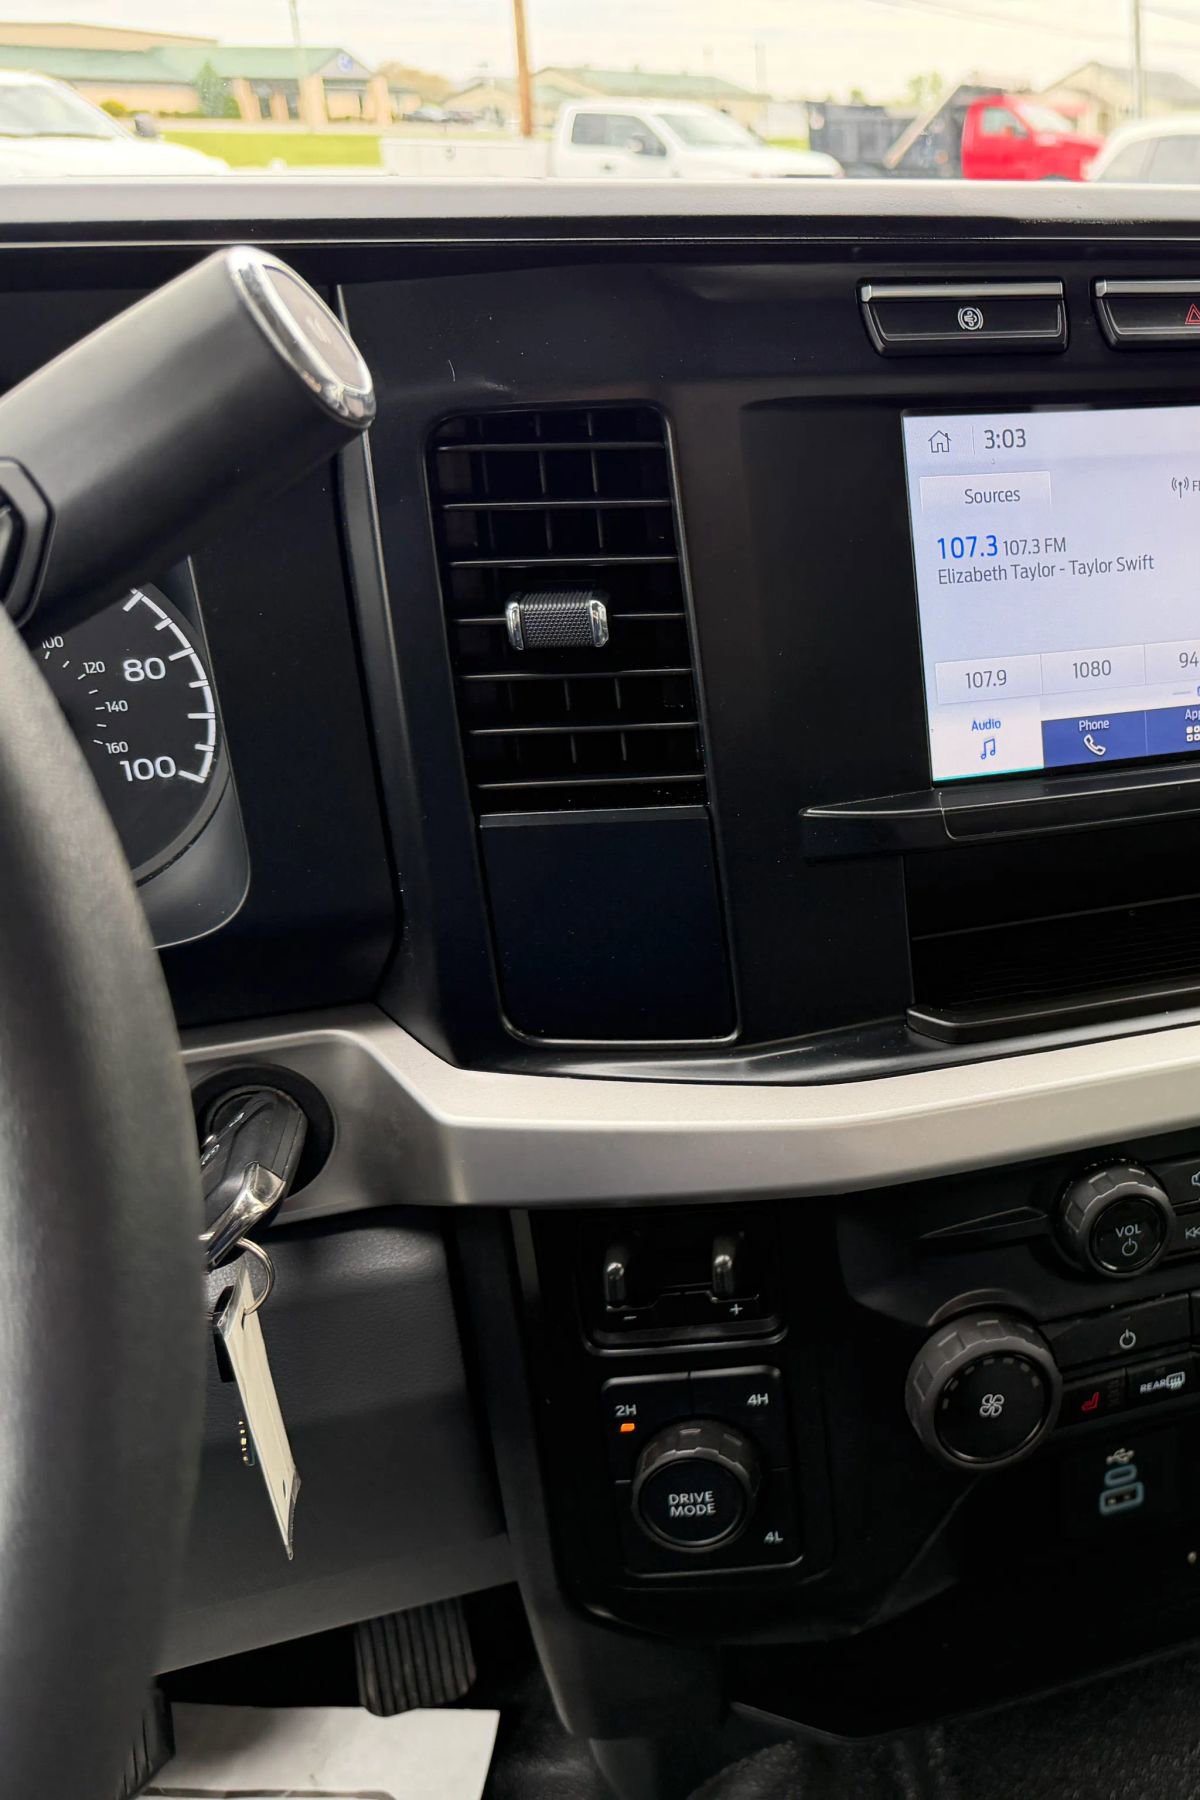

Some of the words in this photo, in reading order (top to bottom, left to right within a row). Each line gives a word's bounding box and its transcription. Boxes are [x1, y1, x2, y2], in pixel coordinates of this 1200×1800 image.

[983, 429, 1027, 450] 3:03
[964, 487, 1021, 505] Sources
[936, 535, 999, 561] 107.3
[1002, 538, 1041, 557] 107.3
[1044, 537, 1067, 554] FM
[938, 563, 1008, 585] Elizabeth
[1011, 560, 1056, 582] Taylor
[1068, 557, 1114, 578] Taylor
[1117, 554, 1155, 573] Swift
[83, 661, 106, 674] 120
[121, 656, 167, 682] 80
[1072, 659, 1112, 679] 1080
[965, 669, 1008, 690] 107.9
[105, 700, 129, 713] 140
[971, 718, 1002, 733] Audio
[1078, 717, 1110, 732] Phone
[105, 741, 129, 754] 160
[119, 755, 177, 782] 100
[1115, 1223, 1142, 1238] VOL
[1139, 1378, 1168, 1394] REAR
[746, 1392, 769, 1407] 4H
[615, 1403, 637, 1418] 2H
[668, 1489, 715, 1506] DRIVE
[669, 1502, 716, 1518] MODE
[763, 1530, 784, 1544] 4L
